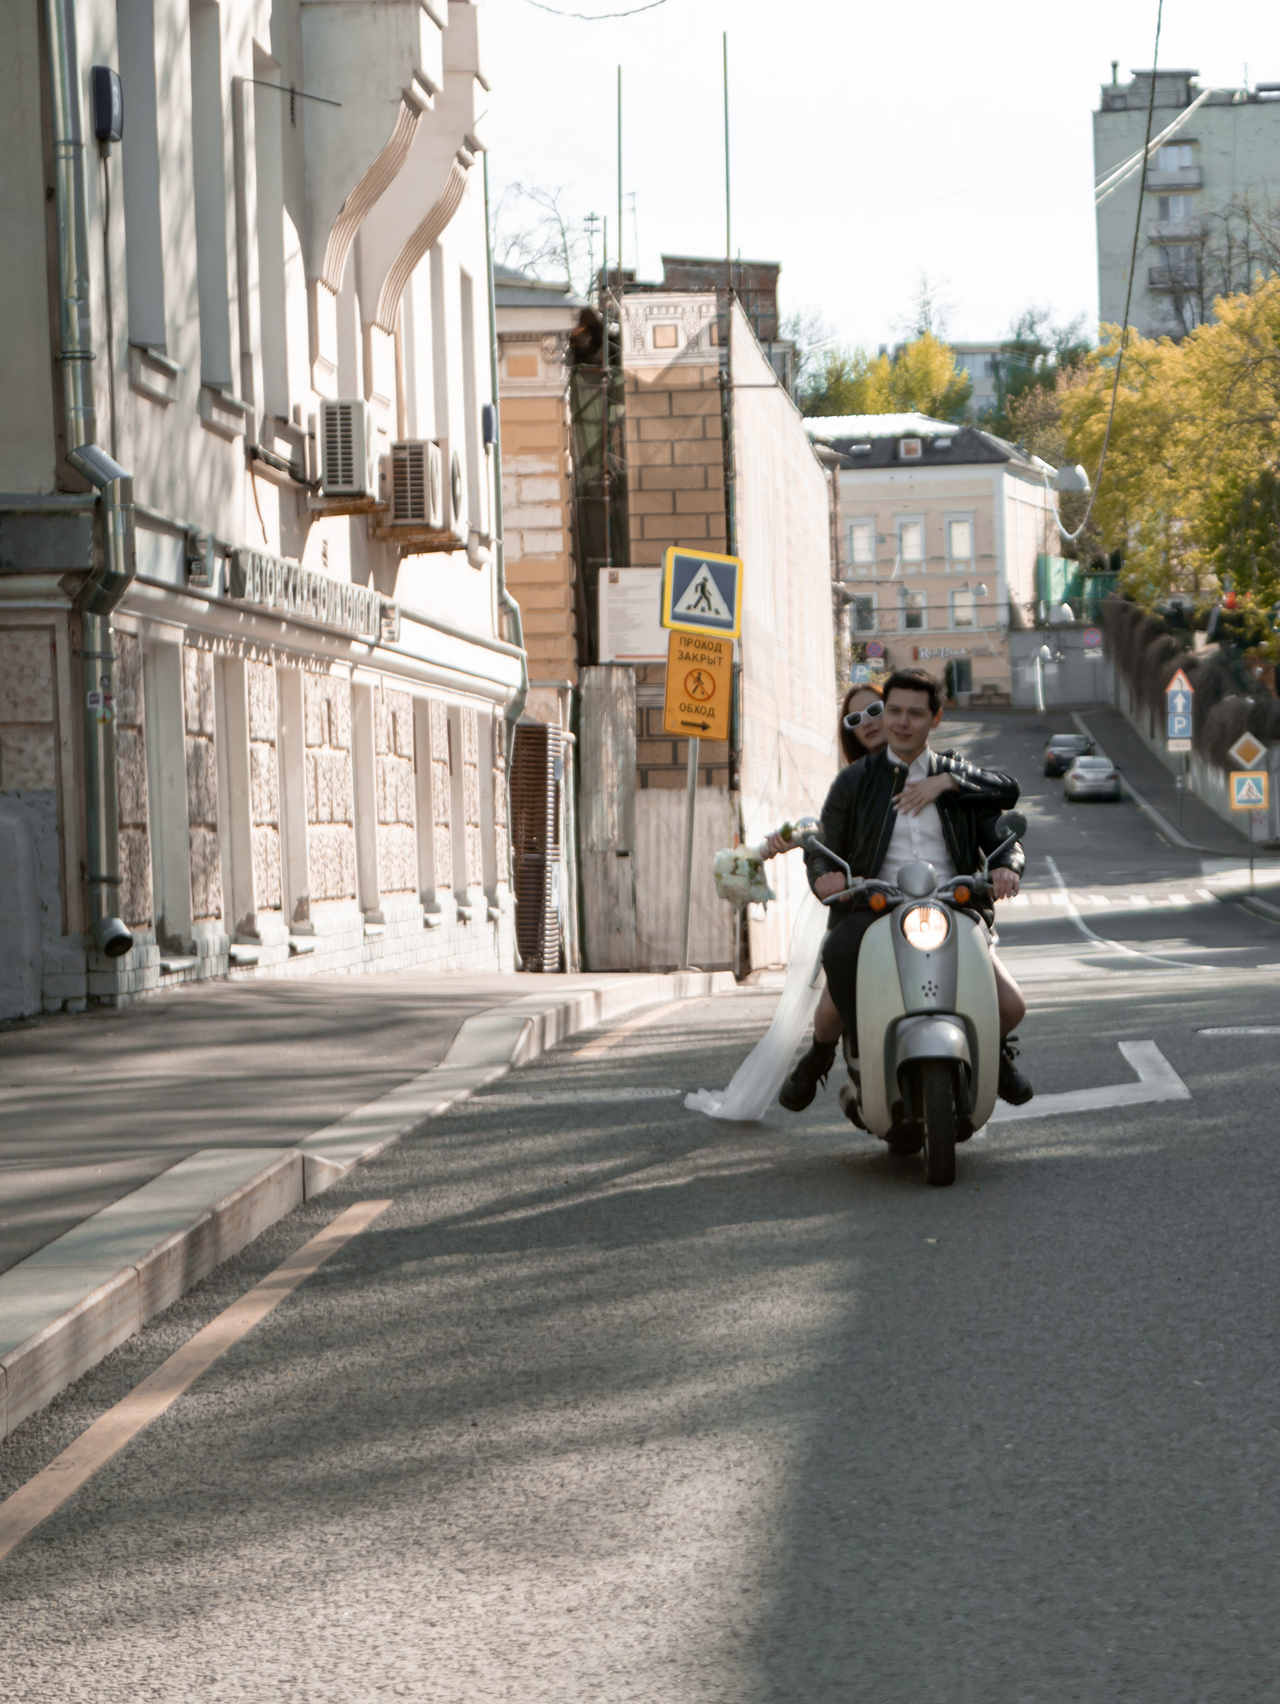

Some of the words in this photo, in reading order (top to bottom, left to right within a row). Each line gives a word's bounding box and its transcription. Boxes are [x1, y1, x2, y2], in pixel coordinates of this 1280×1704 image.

[245, 551, 308, 615] АВТОРСКАЯ
[679, 636, 722, 653] ПРОХОД
[678, 650, 723, 666] ЗАКРЫТ
[679, 703, 715, 718] ОБХОД
[1174, 716, 1187, 734] P
